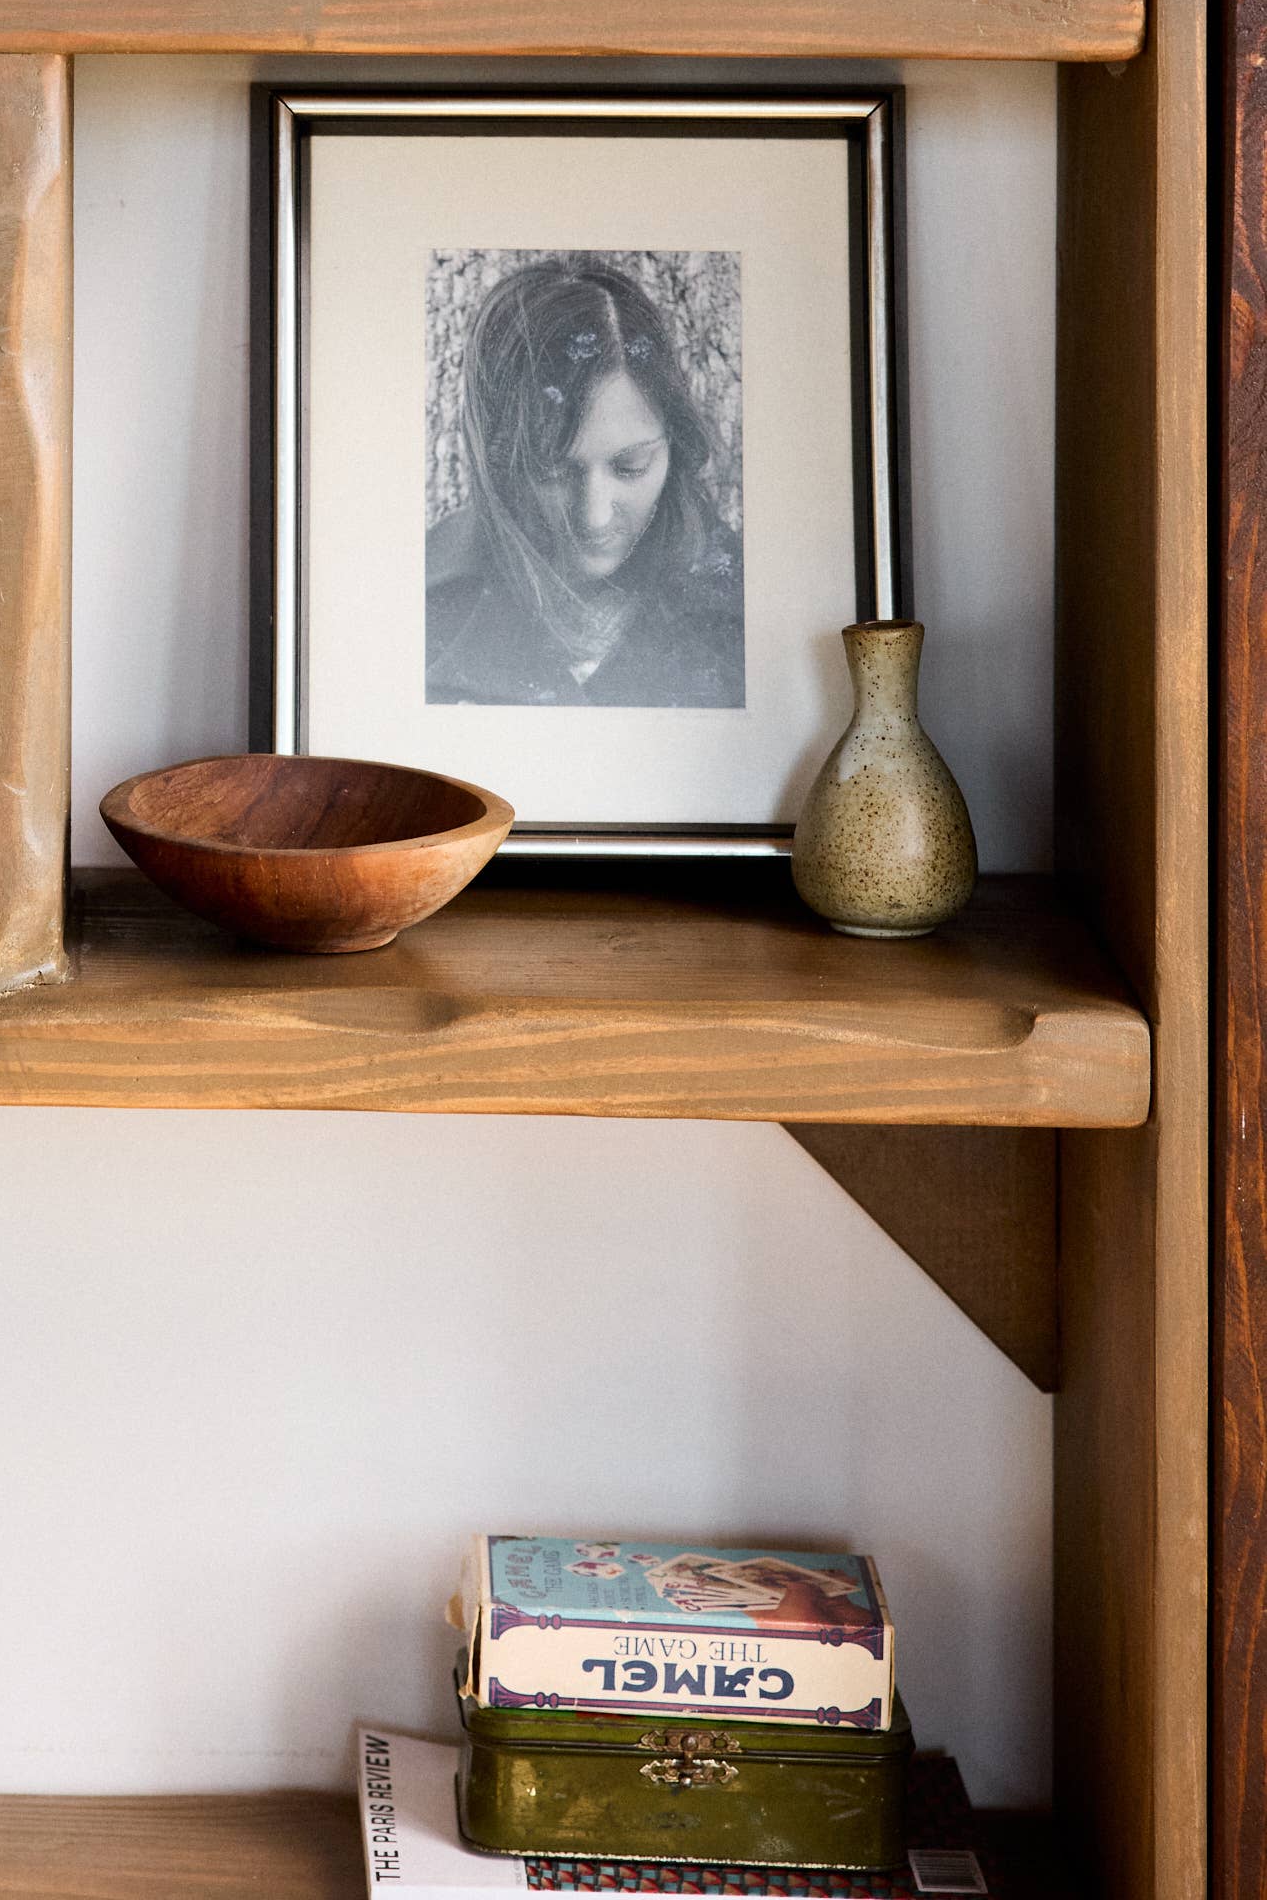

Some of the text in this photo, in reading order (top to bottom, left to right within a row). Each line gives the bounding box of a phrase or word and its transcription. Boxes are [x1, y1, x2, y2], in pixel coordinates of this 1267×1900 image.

[614, 1635, 769, 1664] THE GAME
[582, 1658, 795, 1701] CAMEL
[365, 1734, 401, 1882] THE PARIS REVIEW
